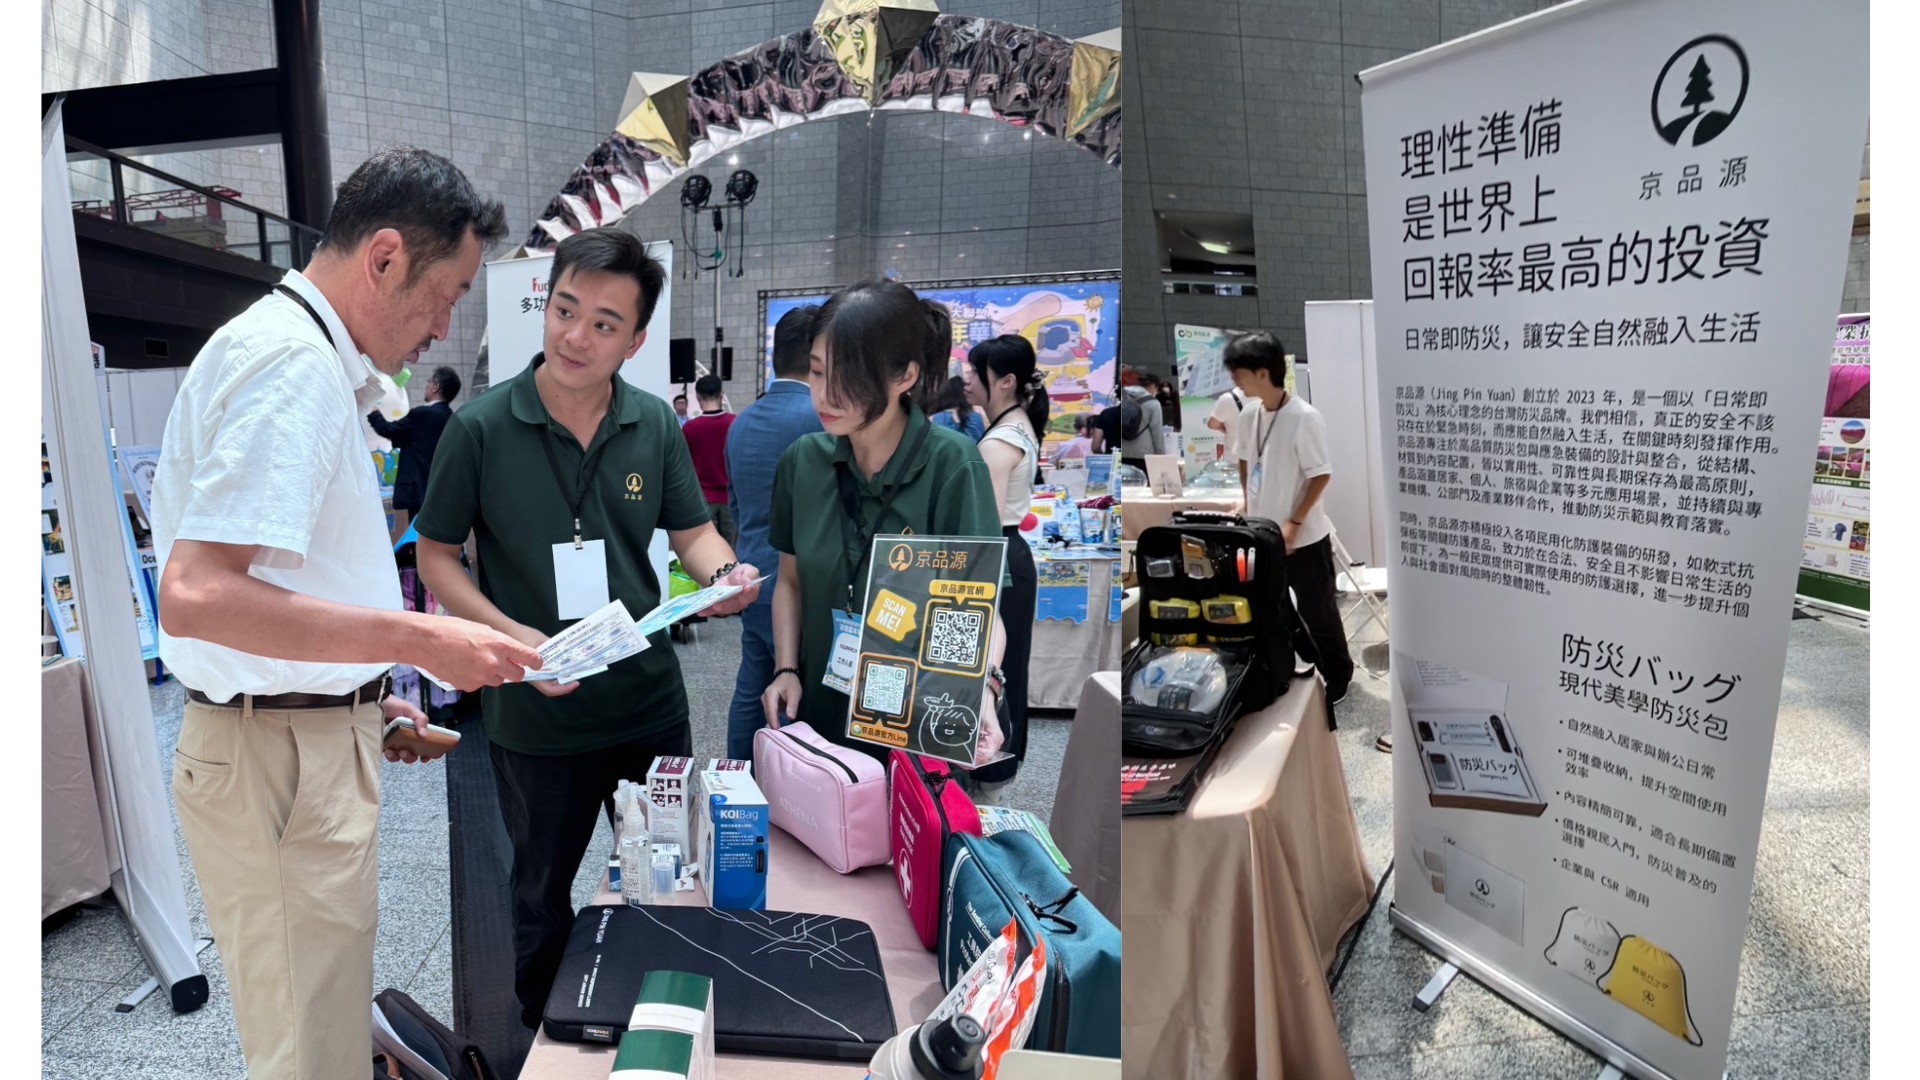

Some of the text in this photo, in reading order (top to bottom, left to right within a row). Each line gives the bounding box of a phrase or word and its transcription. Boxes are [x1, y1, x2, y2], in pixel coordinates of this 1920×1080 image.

[1401, 98, 1563, 180] 理性準備
[1639, 156, 1748, 200] 京品源
[1403, 174, 1558, 243] 是世界上
[1404, 217, 1769, 302] 回報率最高的投資
[1405, 311, 1761, 352] 日常即防災，讓安全自然融入生活
[1395, 386, 1425, 399] 京品源
[1464, 388, 1481, 400] Pin
[1523, 388, 1560, 403] 創立於
[1567, 390, 1595, 404] 2023
[915, 550, 968, 570] 京品源
[882, 597, 907, 617] SCAN
[939, 583, 985, 596] 京品源官網
[875, 611, 902, 632] ME!
[1562, 633, 1741, 705] 防災バッグ
[1559, 670, 1730, 742] 現代美學防災包
[1459, 758, 1518, 775] 防災バッグ
[1565, 762, 1589, 779] 效率
[1568, 718, 1716, 781] 自然融入居家與辦公日常
[1566, 747, 1728, 817] 可堆疊收納，提升空間使用
[720, 809, 759, 821] KOIBag
[1564, 791, 1737, 868] 內容精簡可靠，適合長期備置
[1562, 831, 1586, 849] 選擇
[1563, 817, 1717, 894] 價格親民入門，防災普及的
[1561, 858, 1650, 908] 企業與 CSR 適用
